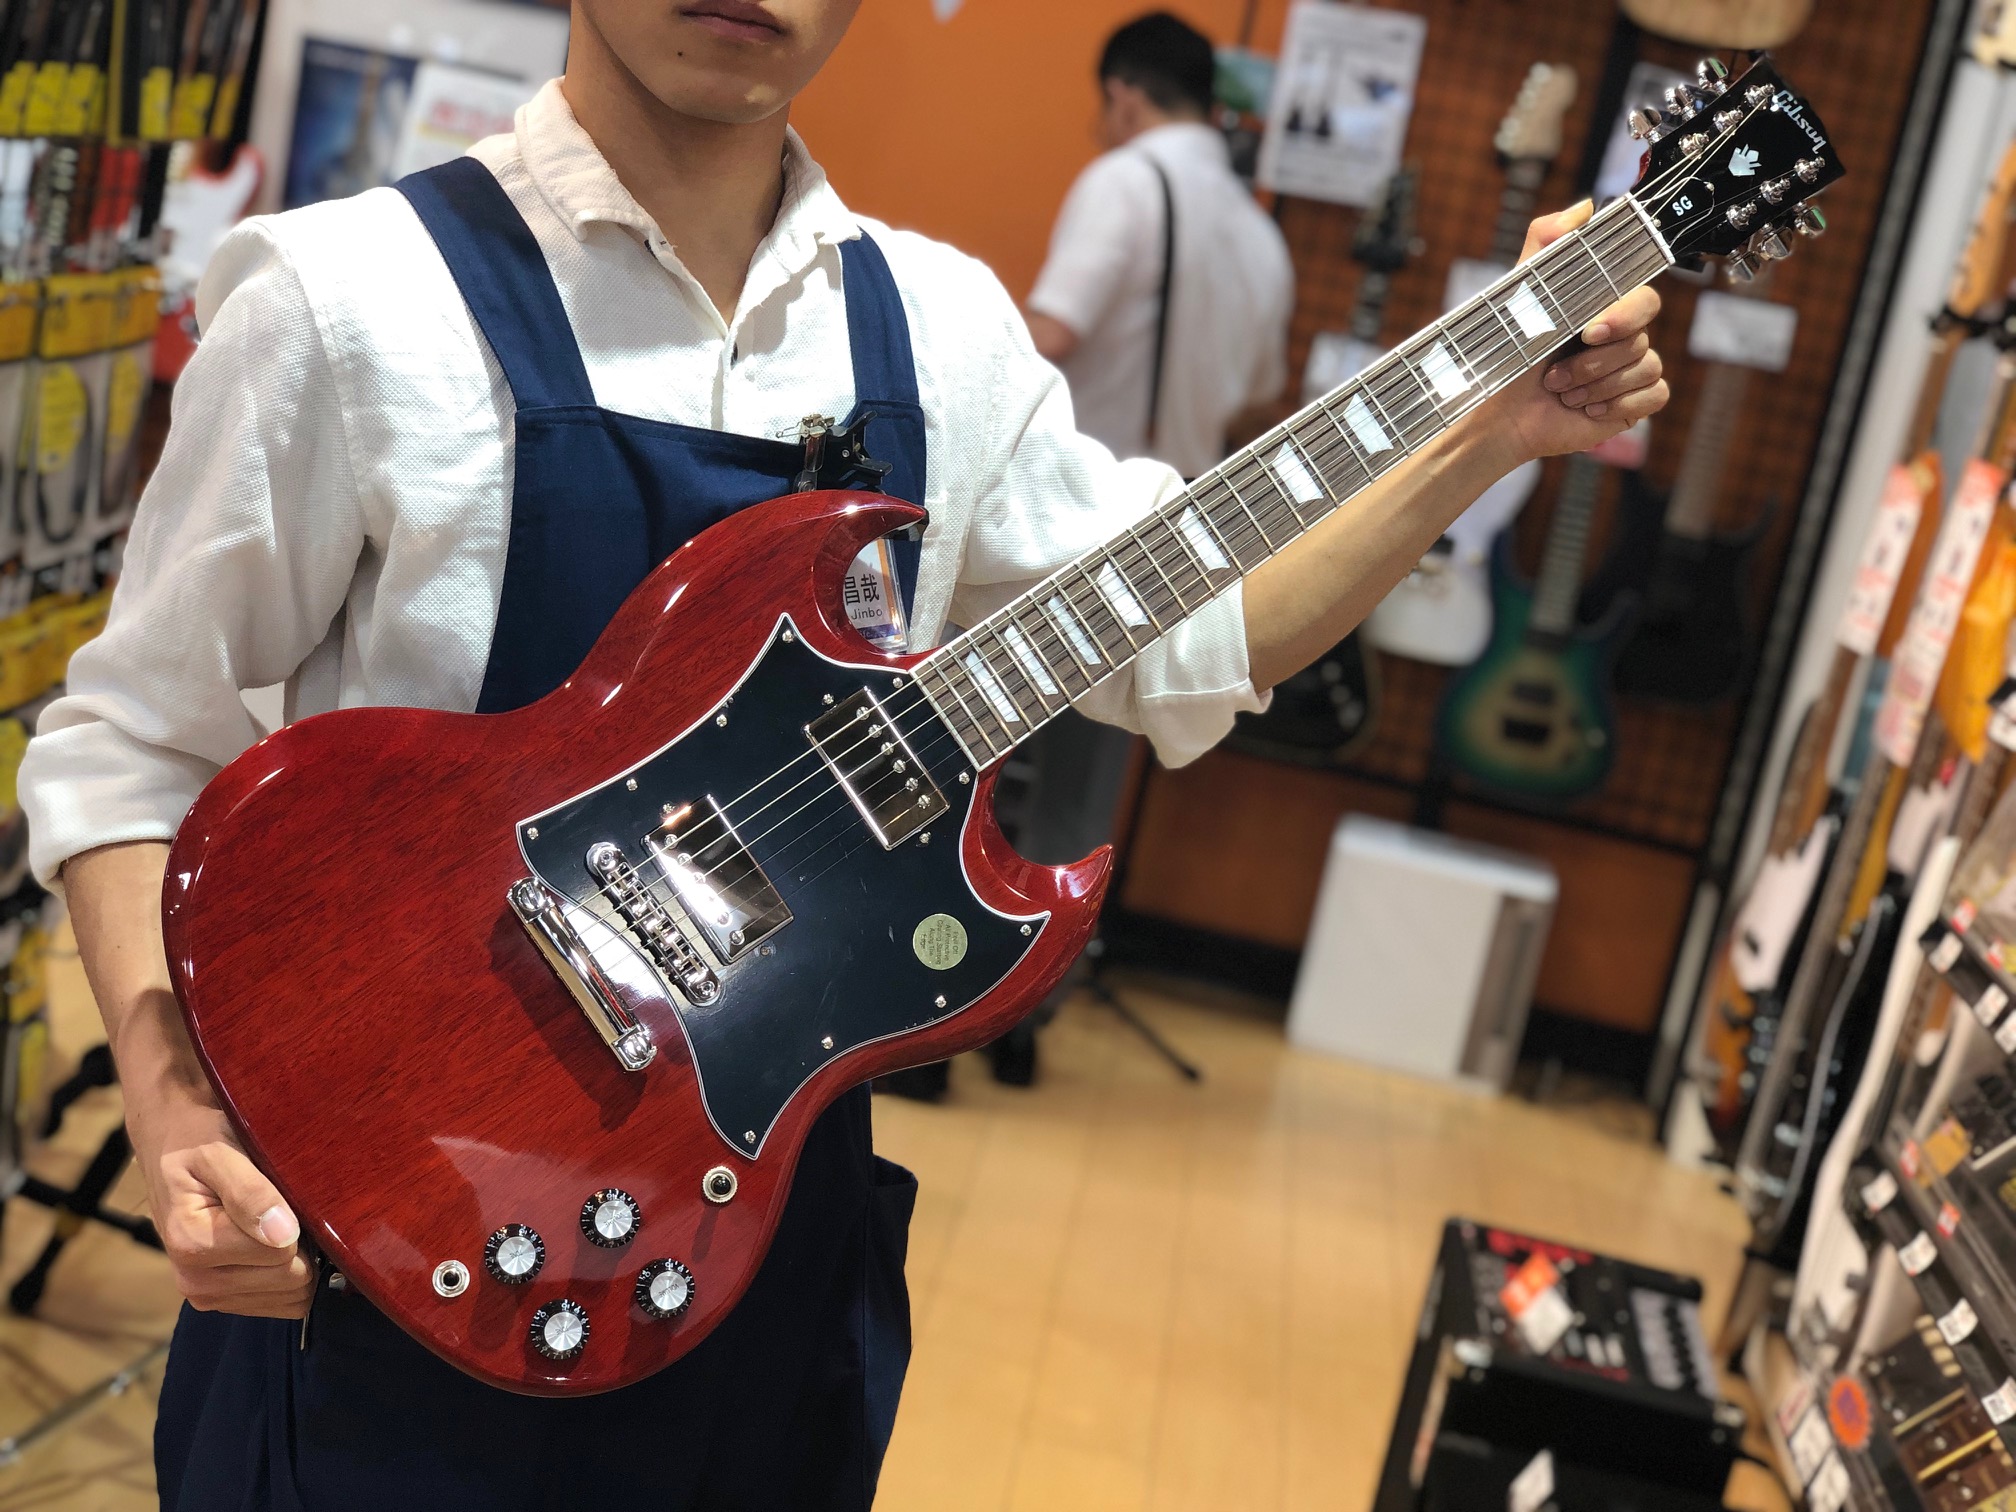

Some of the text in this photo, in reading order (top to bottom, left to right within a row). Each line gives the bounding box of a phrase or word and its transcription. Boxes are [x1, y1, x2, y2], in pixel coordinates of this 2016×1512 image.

[1770, 89, 1827, 154] Gibson
[1672, 195, 1694, 217] SG
[844, 573, 880, 606] 昌哉
[851, 607, 883, 620] Jinbo
[658, 1283, 679, 1298] VOLUME
